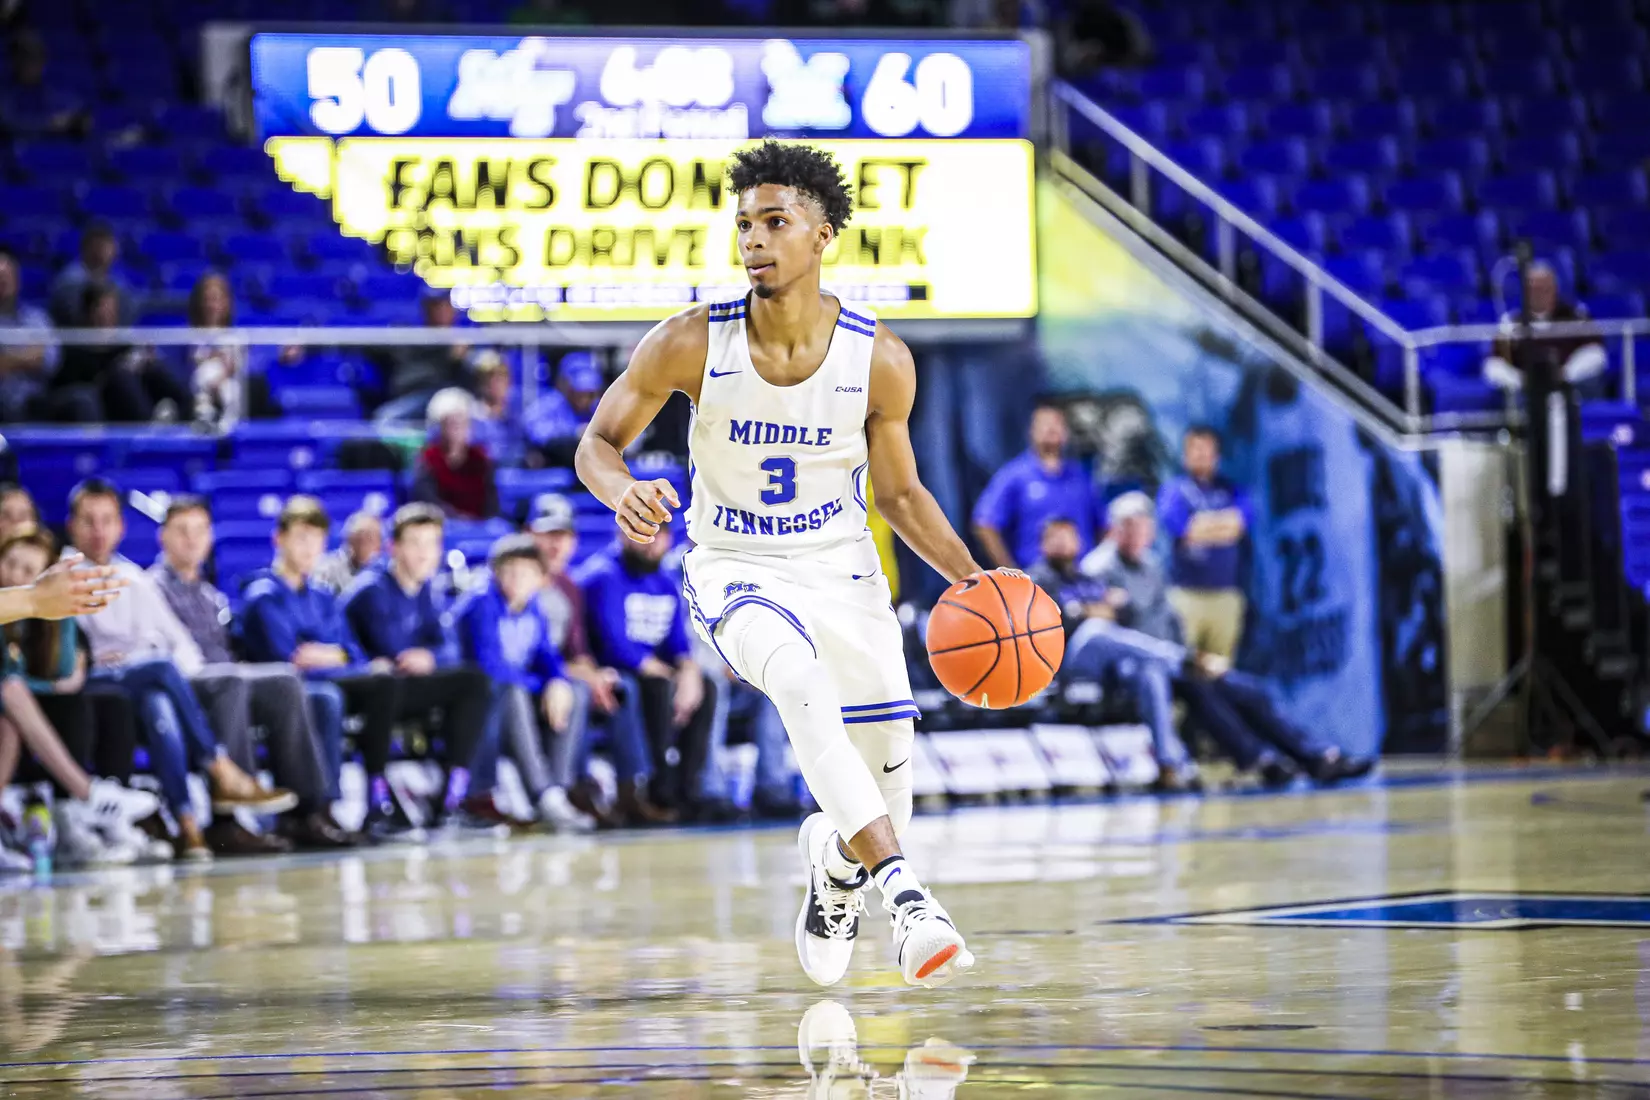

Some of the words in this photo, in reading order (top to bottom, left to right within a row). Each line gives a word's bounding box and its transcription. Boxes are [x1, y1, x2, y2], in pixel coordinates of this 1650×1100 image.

[307, 46, 422, 135] 50
[862, 51, 975, 137] 60
[389, 158, 556, 210] FANS
[582, 158, 724, 210] DON
[858, 159, 928, 210] ET
[728, 418, 833, 446] MIDDLE
[758, 454, 799, 508] 3
